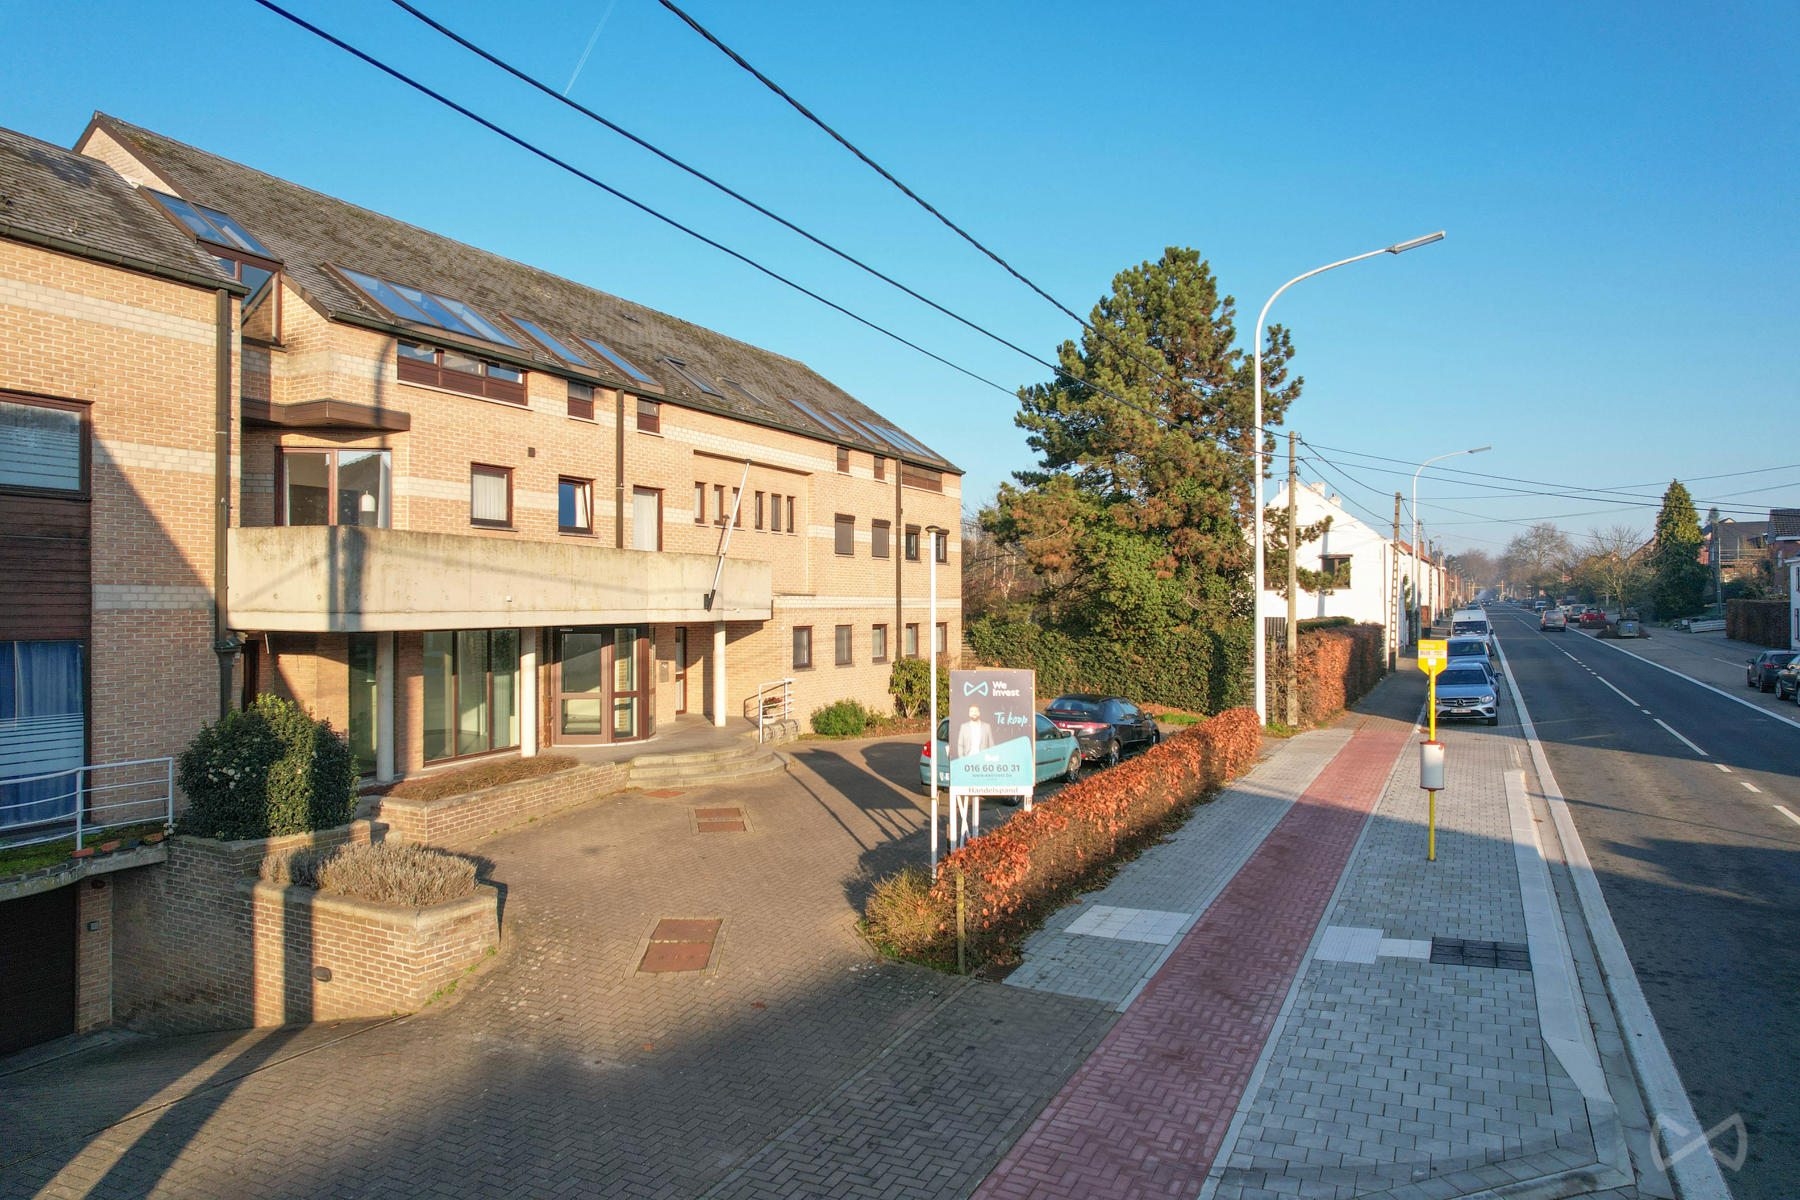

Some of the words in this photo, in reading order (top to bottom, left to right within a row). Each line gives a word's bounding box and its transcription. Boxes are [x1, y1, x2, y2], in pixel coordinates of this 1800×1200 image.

[992, 681, 1007, 690] We
[992, 689, 1020, 697] Invest
[994, 712, 1005, 725] Te
[1007, 712, 1028, 728] koop
[964, 764, 980, 772] 016
[982, 764, 994, 772] 60
[996, 764, 1008, 772] 60
[1011, 764, 1020, 772] 31
[969, 786, 1019, 795] Handelspand
